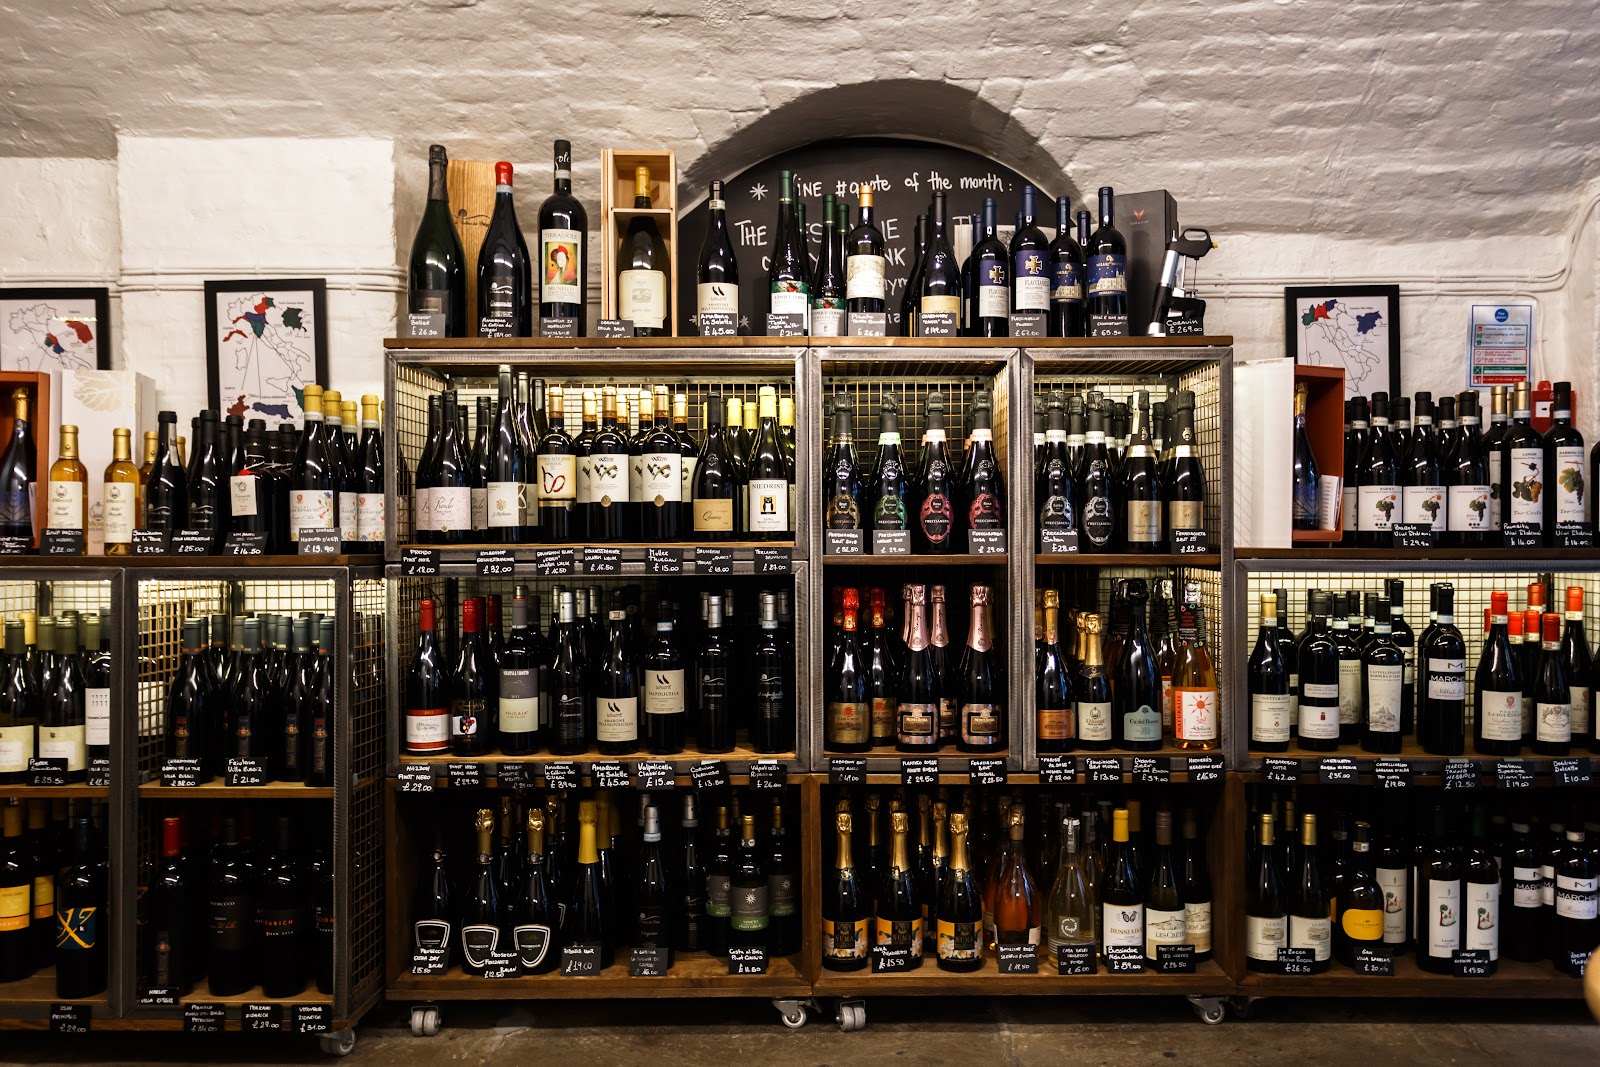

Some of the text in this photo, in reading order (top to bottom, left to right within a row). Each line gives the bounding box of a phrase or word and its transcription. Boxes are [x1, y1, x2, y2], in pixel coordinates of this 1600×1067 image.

[905, 172, 919, 193] of
[928, 171, 953, 193] the
[735, 219, 767, 246] THE
